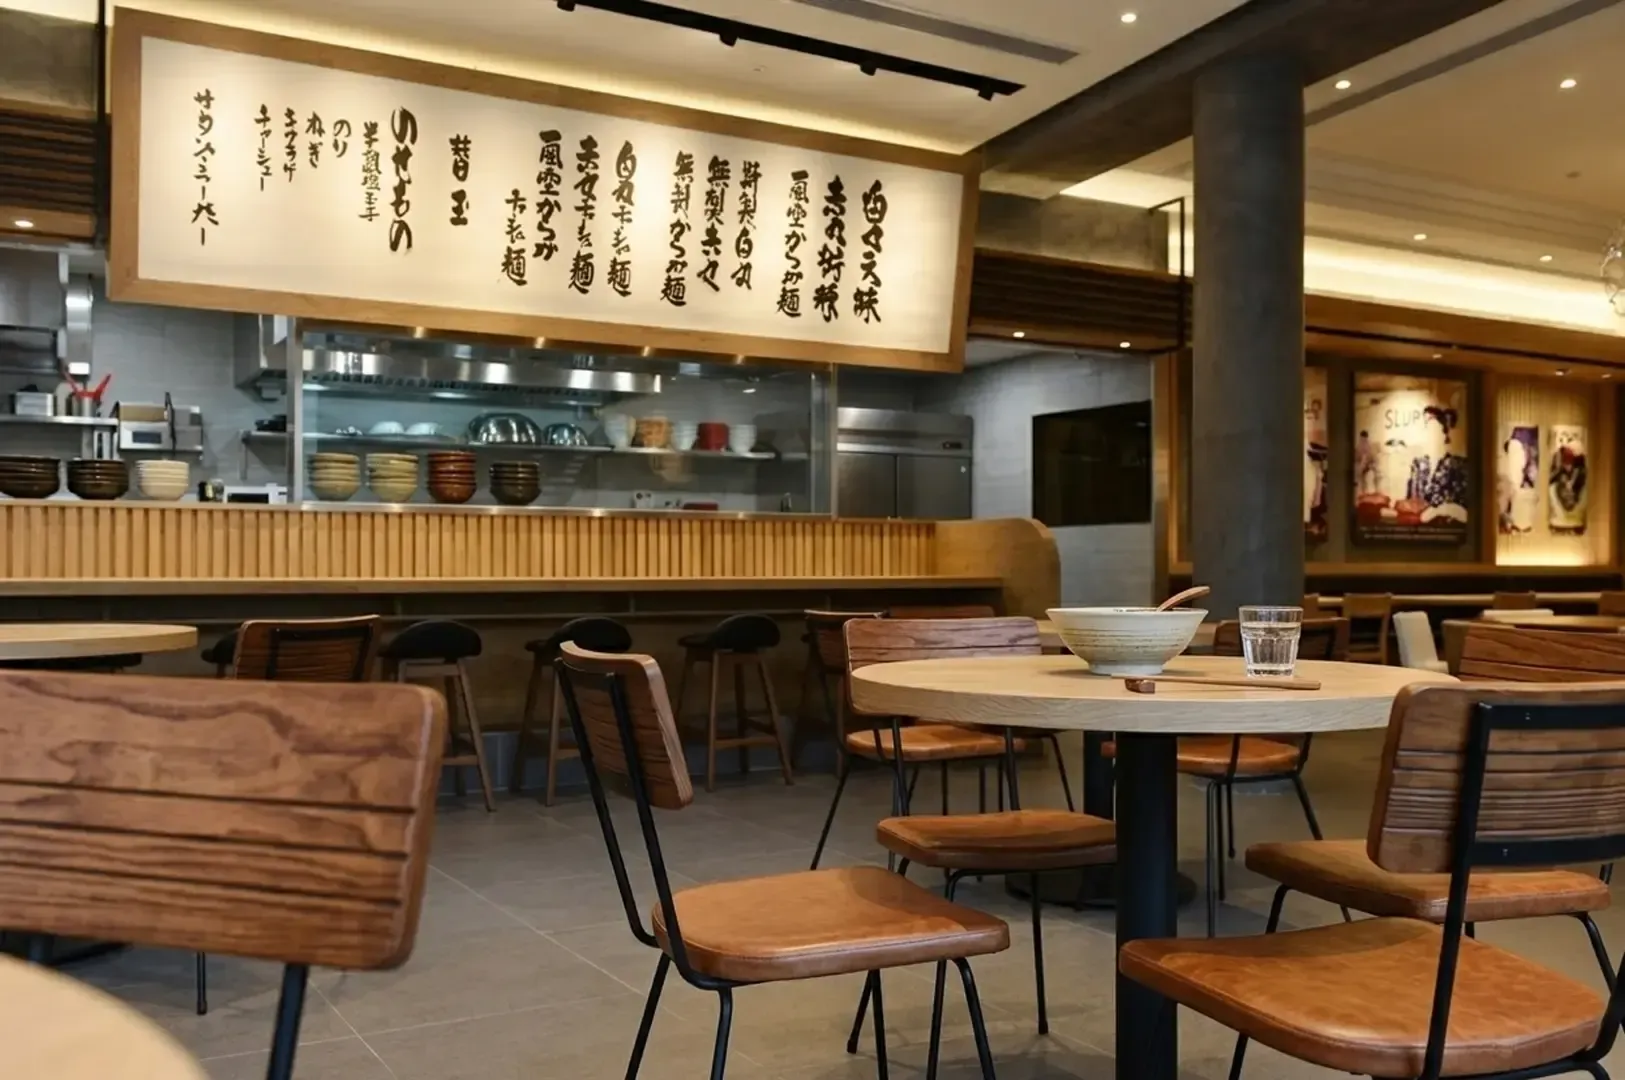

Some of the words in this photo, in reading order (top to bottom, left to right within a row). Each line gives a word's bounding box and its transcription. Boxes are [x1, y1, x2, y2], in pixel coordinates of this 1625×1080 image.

[304, 111, 326, 169] ねぎ
[332, 119, 352, 159] のり
[389, 106, 418, 253] のせもの
